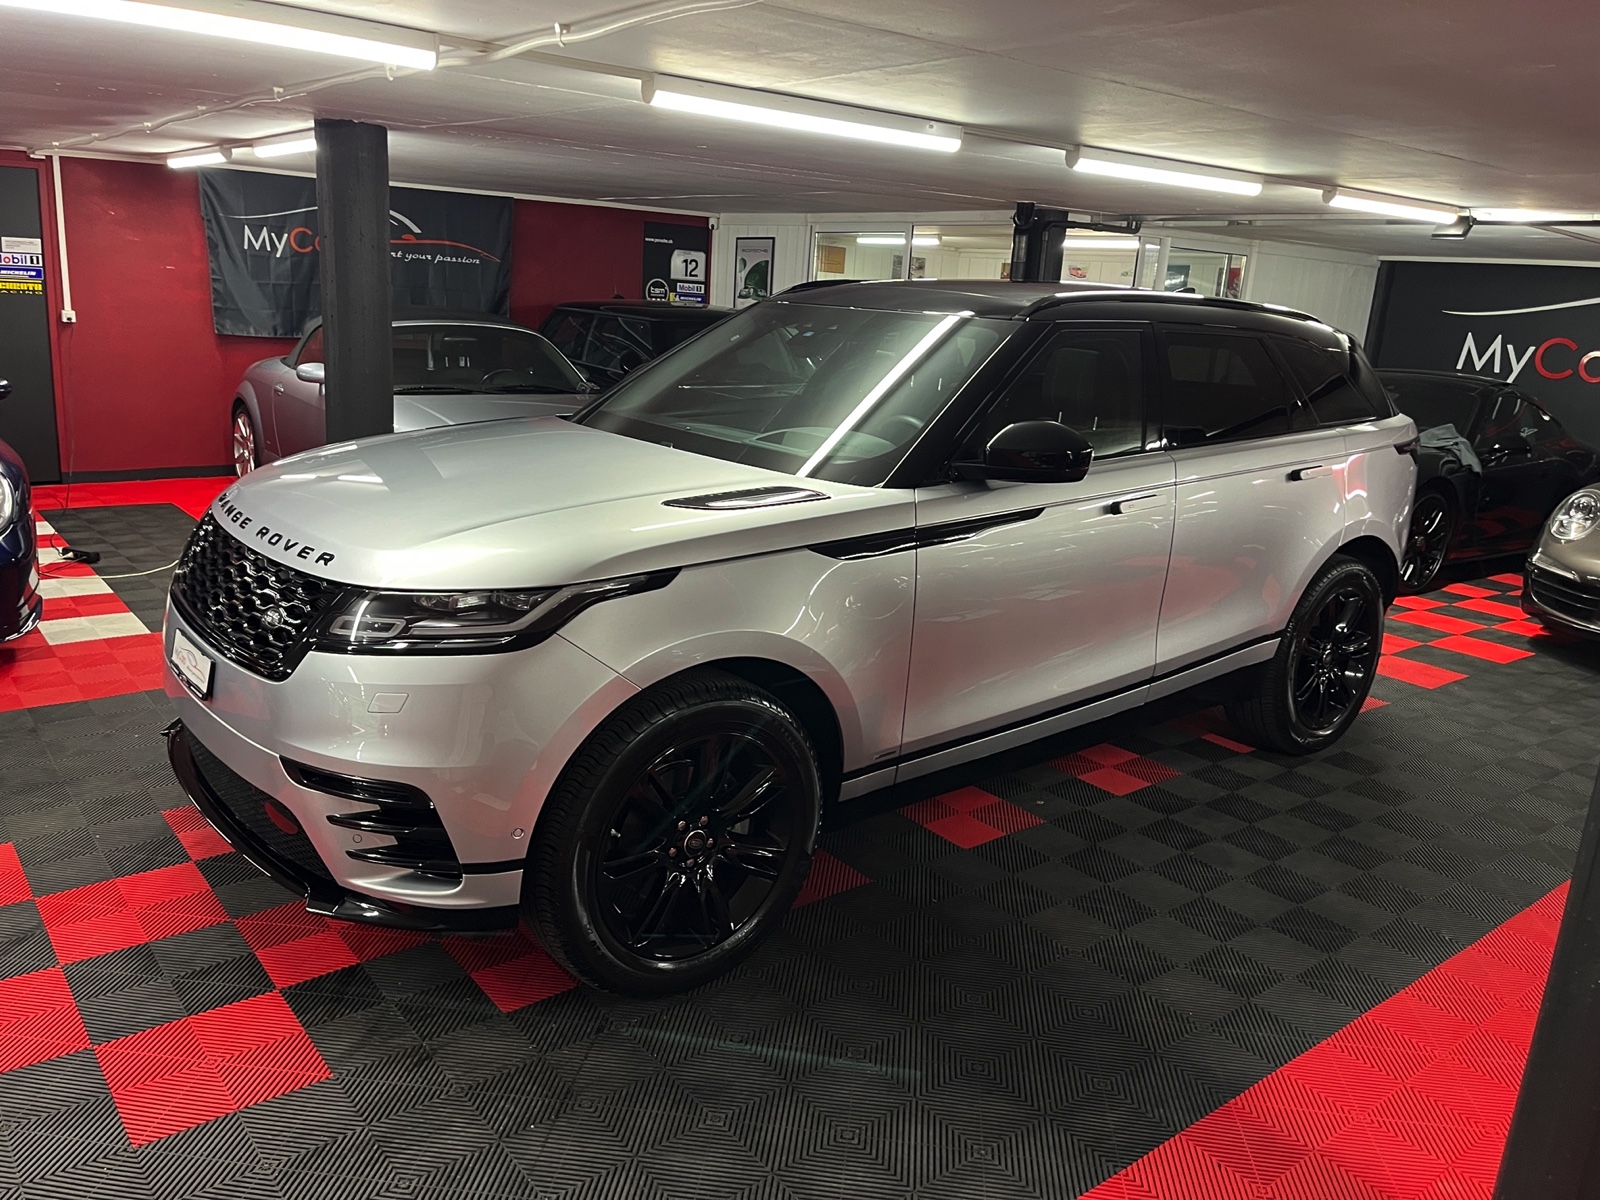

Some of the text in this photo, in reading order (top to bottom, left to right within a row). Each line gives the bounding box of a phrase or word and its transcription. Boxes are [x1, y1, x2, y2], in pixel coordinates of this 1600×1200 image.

[244, 224, 320, 257] MyC
[404, 252, 432, 262] your
[434, 254, 480, 264] passion
[681, 258, 699, 277] 12
[679, 284, 695, 292] Mobil
[218, 493, 335, 566] RANGE ROVER
